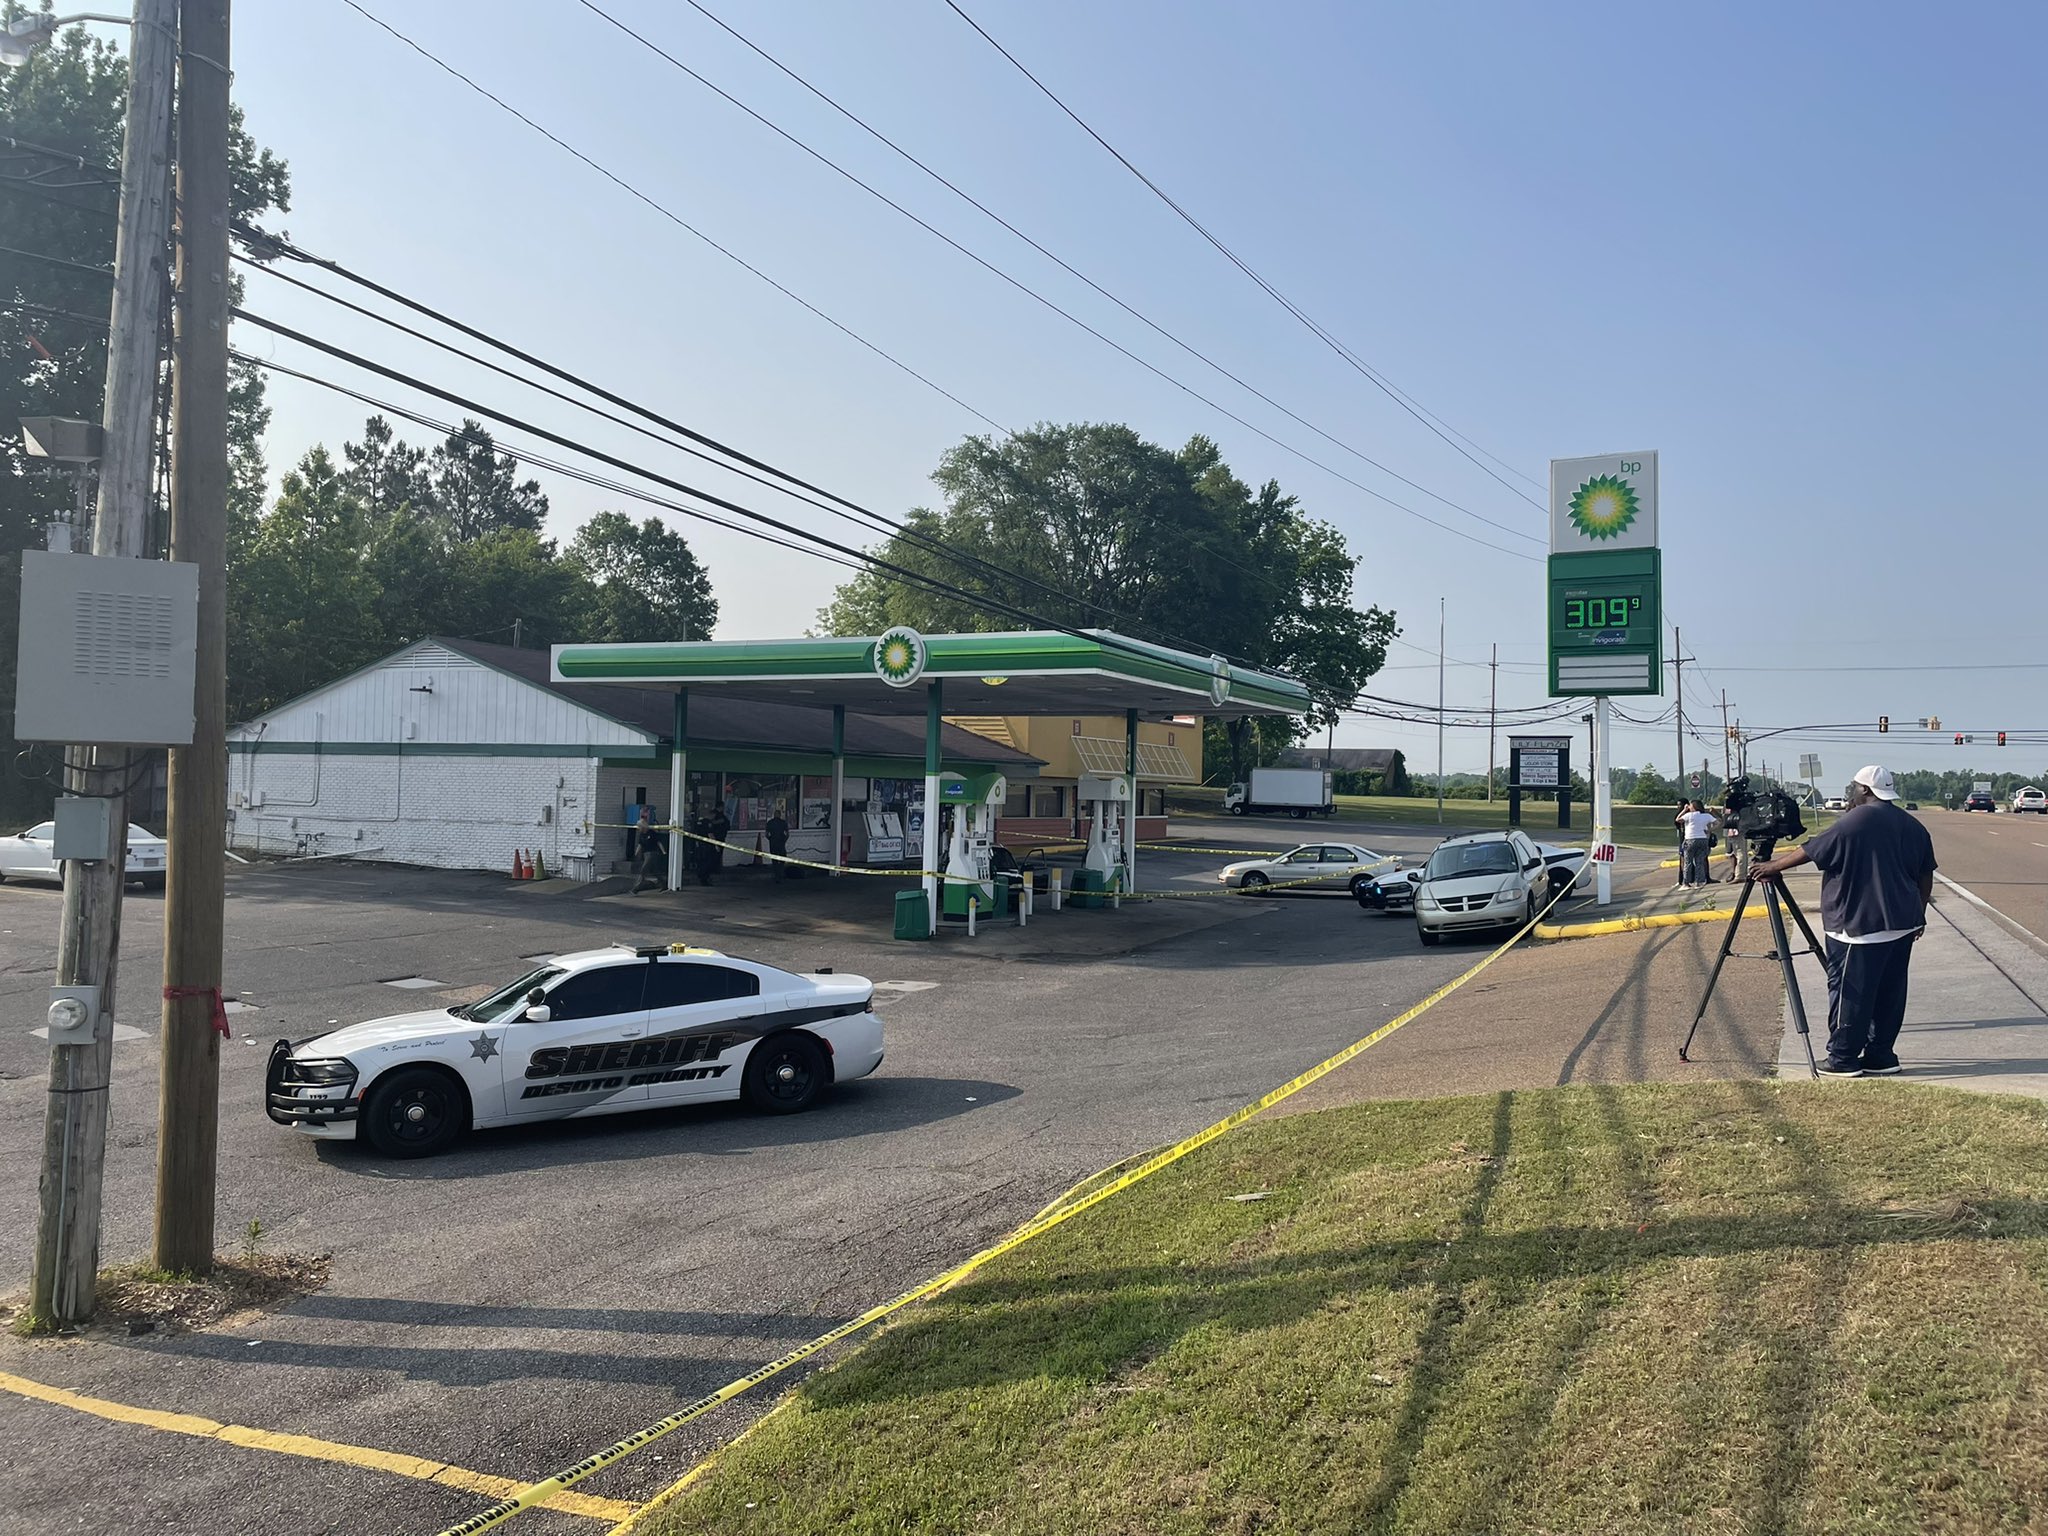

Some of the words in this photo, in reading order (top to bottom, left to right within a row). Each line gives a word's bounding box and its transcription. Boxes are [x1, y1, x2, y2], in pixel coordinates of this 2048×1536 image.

[1620, 460, 1641, 475] bp
[1567, 598, 1628, 628] 309
[1593, 844, 1615, 862] AIR
[524, 1031, 736, 1080] SHERIFF
[520, 1076, 624, 1099] DESOTO
[628, 1064, 733, 1087] COUNTY
